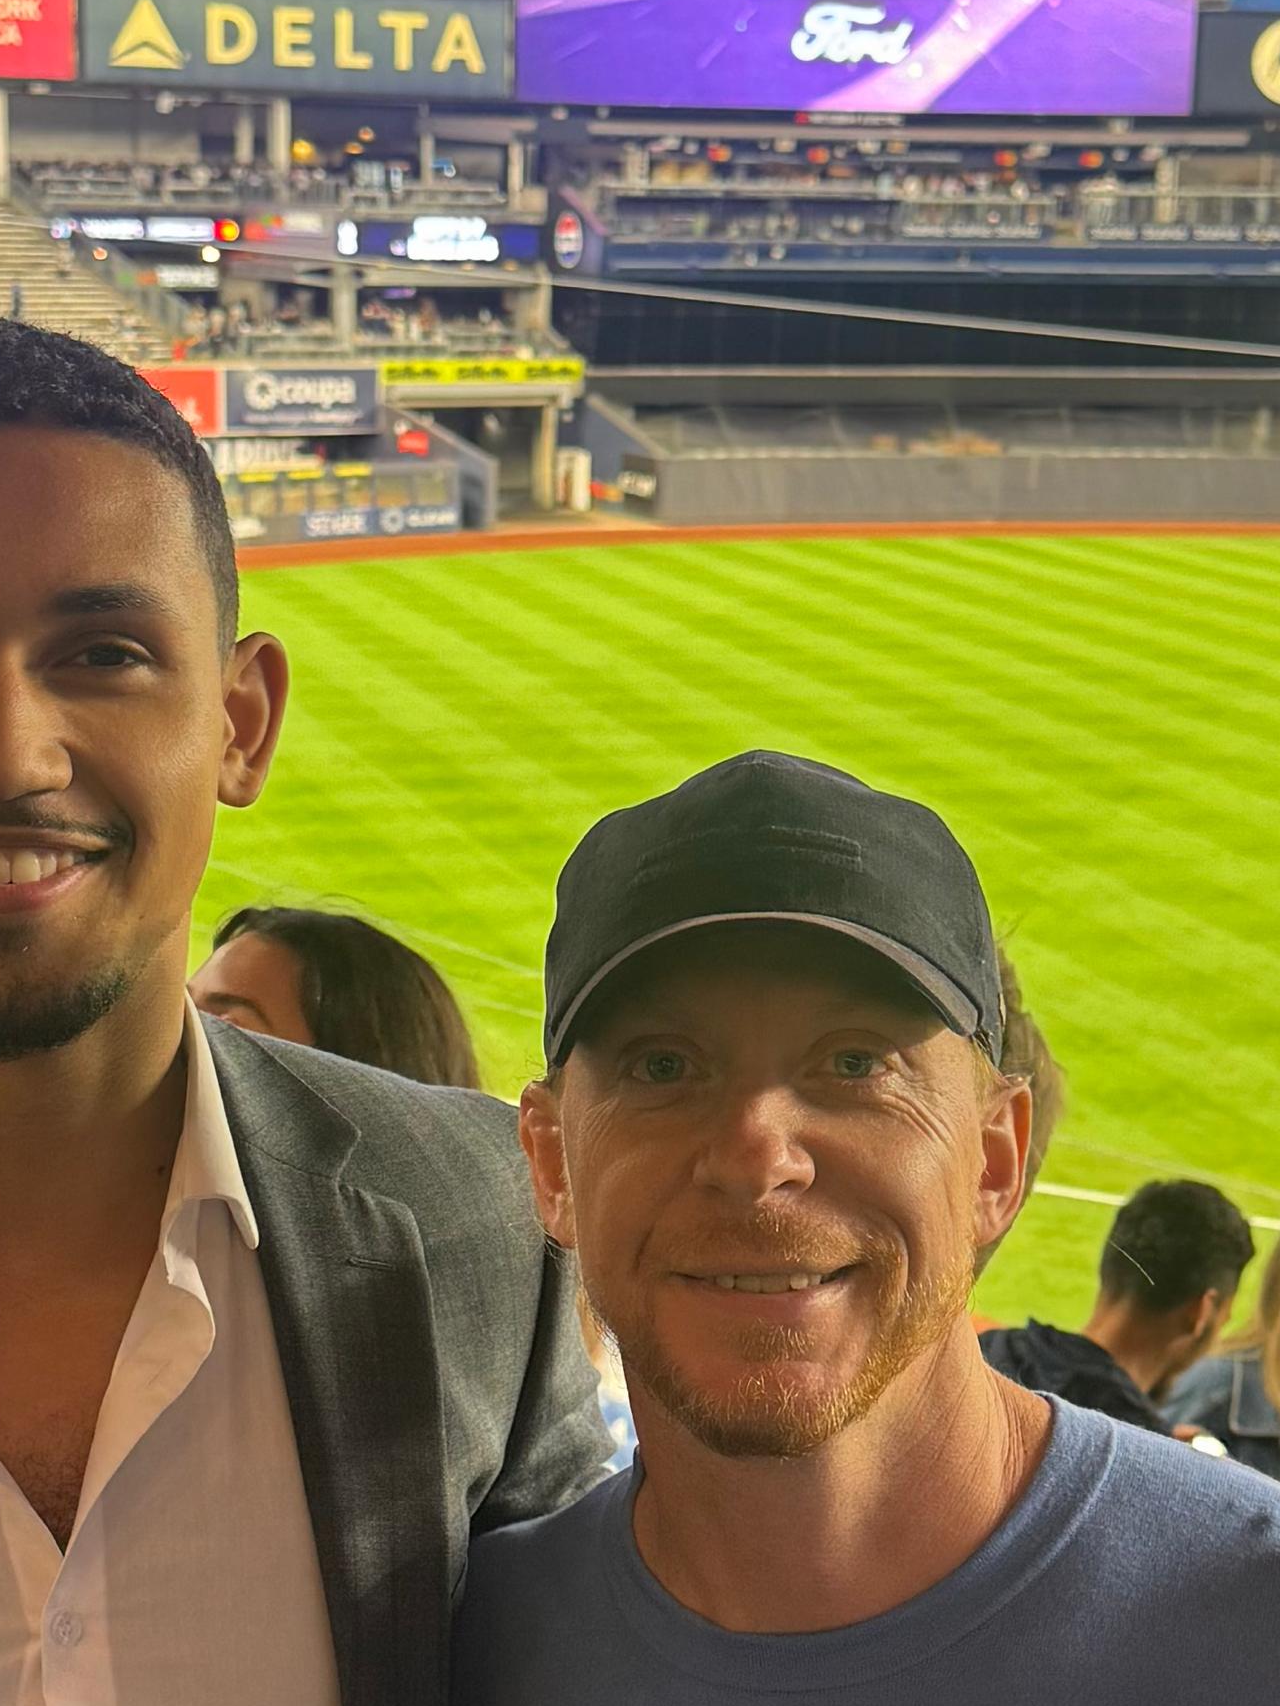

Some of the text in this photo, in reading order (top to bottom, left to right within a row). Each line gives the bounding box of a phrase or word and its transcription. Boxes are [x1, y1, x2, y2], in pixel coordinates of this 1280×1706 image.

[204, 1, 486, 75] DELTA
[790, 0, 915, 65] Ford
[278, 376, 357, 410] coupa
